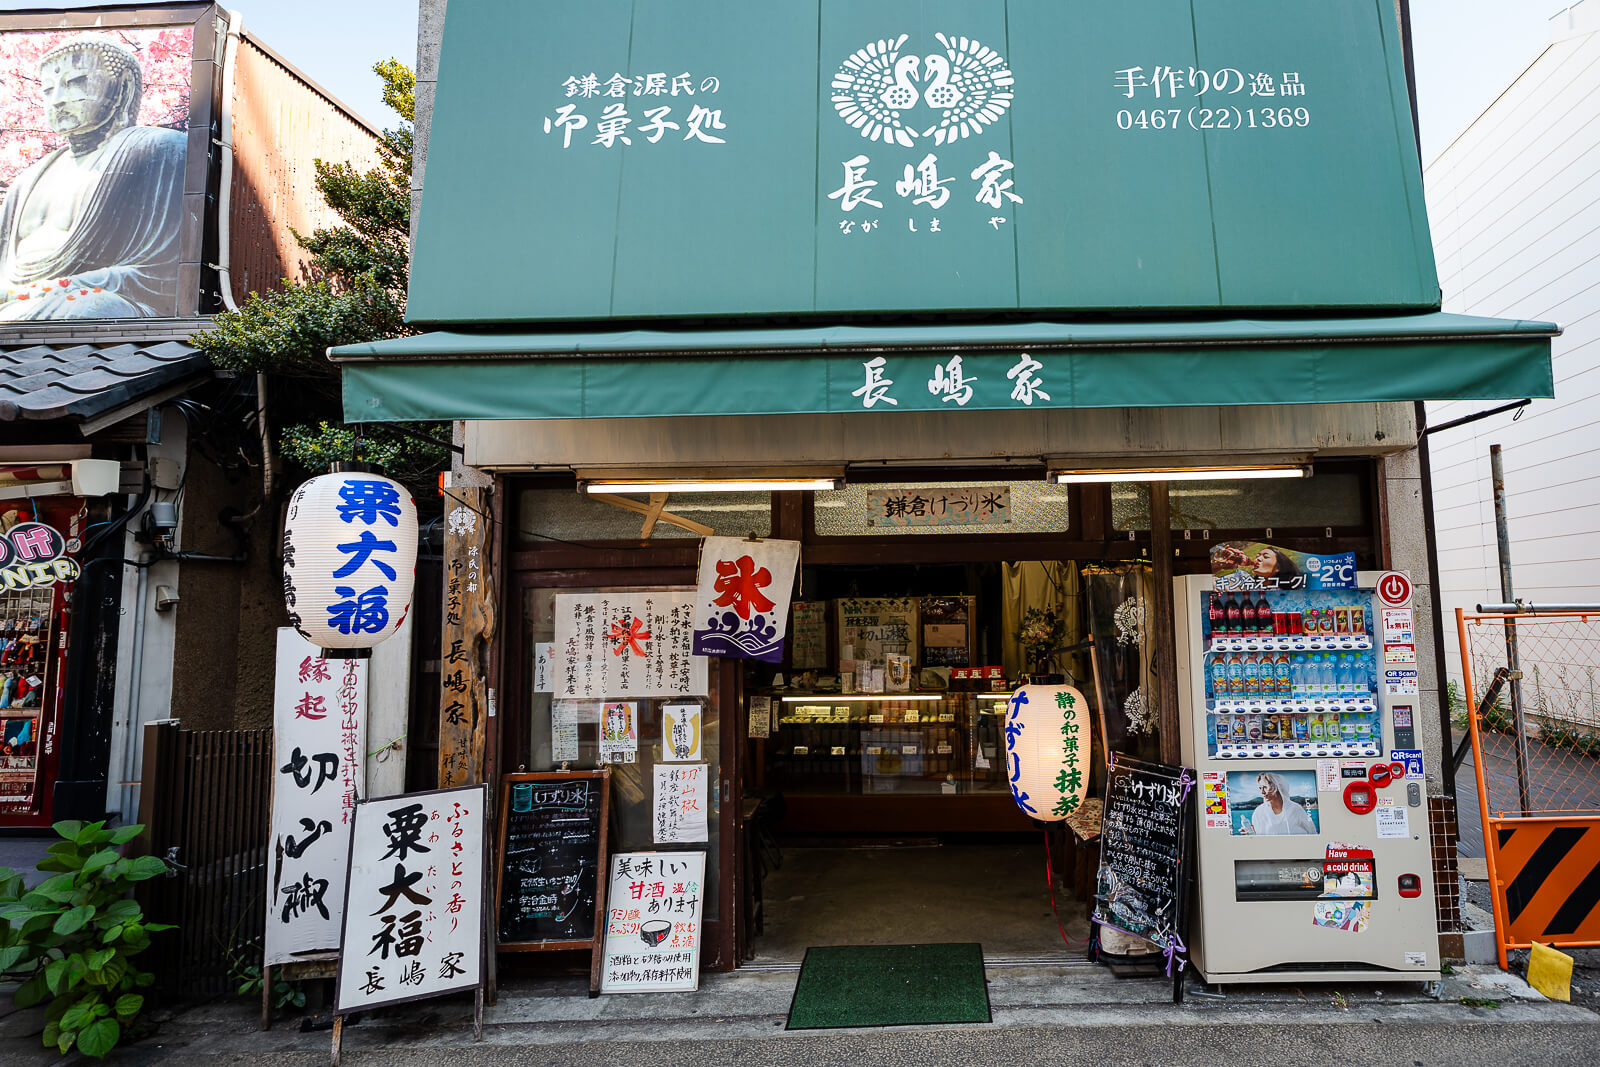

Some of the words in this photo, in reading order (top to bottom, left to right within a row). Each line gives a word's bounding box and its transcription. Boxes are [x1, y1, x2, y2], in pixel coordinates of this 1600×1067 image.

[561, 72, 720, 98] 鎌倉源氏の
[1113, 66, 1307, 100] 手作りの逸品
[1116, 107, 1311, 131] 0467(22)1369
[828, 151, 1024, 212] 長嶋家
[851, 353, 1052, 408] 長嶋家
[884, 491, 1007, 519] 鎌倉けづり氷
[712, 554, 777, 620] 氷
[294, 655, 332, 721] 縁起
[443, 639, 471, 726] 長嶋家
[442, 752, 456, 788] 祥来
[1328, 849, 1348, 858] Have
[1332, 863, 1349, 872] cold
[1349, 863, 1369, 871] drink
[444, 802, 470, 936] ふるさとの香り
[614, 857, 688, 882] 美味しい
[628, 880, 665, 900] 甘酒
[648, 894, 699, 920] あります
[669, 935, 696, 948] 点滴
[673, 921, 697, 934] 飲む
[358, 950, 468, 998] 長嶋家
